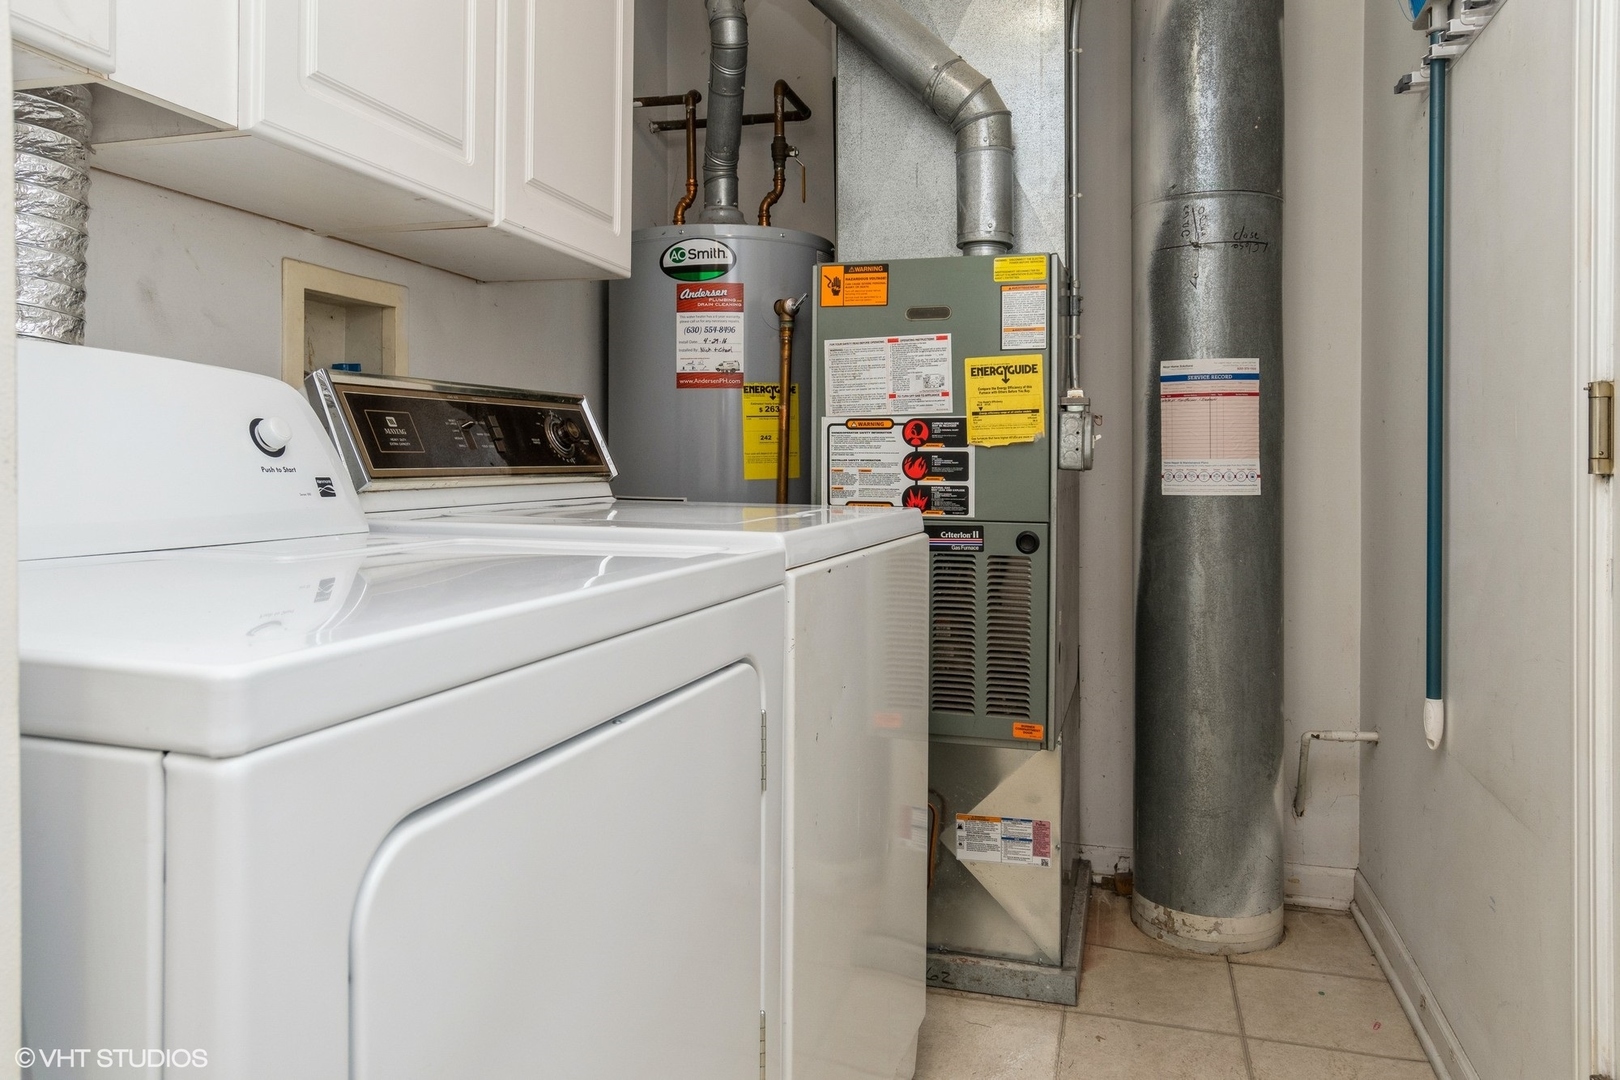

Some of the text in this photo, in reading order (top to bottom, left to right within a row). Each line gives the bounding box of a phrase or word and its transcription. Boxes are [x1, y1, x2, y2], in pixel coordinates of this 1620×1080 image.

[680, 288, 728, 300] Andersen
[684, 326, 702, 335] (630)
[970, 364, 1039, 377] ENERGYGUIDE
[940, 531, 971, 539] Criterion
